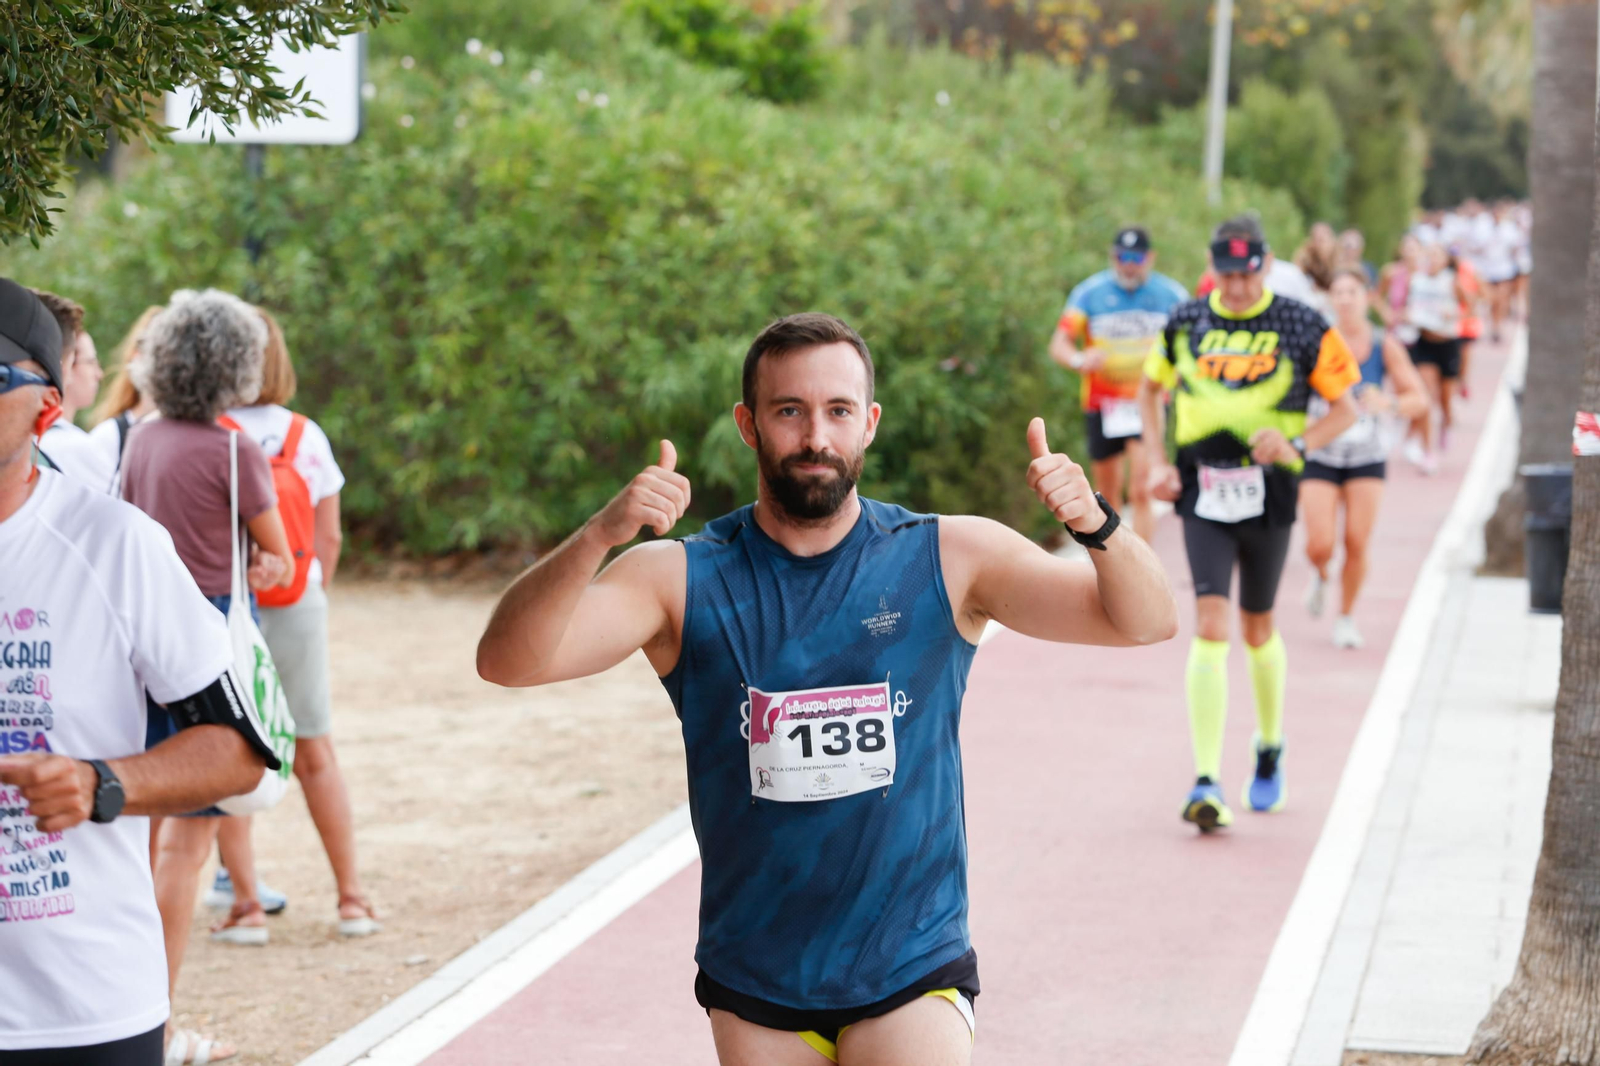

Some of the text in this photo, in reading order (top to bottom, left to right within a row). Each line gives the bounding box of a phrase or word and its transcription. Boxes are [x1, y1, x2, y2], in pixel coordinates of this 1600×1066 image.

[867, 619, 897, 631] RUNNERS
[0, 730, 53, 754] ISA
[787, 718, 886, 759] 138
